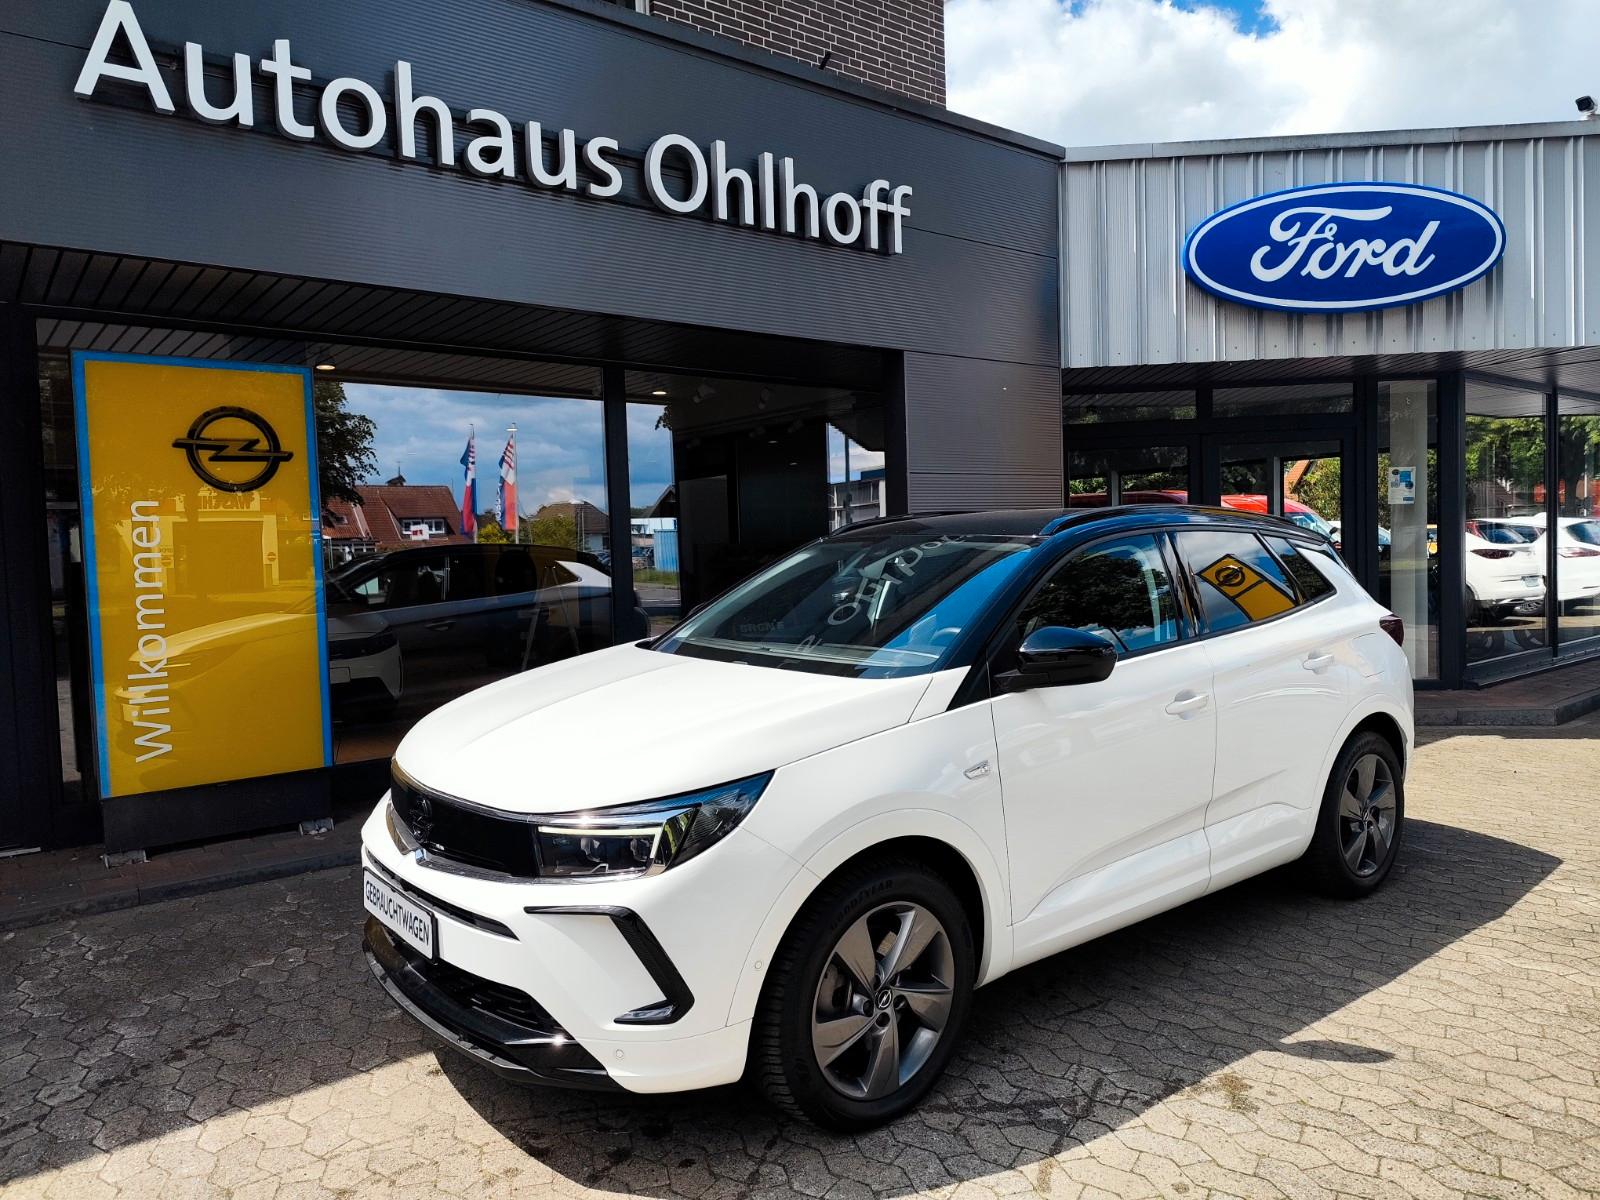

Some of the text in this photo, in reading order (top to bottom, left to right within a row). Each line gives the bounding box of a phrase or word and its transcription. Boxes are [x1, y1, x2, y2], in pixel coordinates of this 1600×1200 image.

[74, 0, 913, 254] Autohaus Ohlhoff
[1250, 205, 1441, 282] Ford
[127, 500, 173, 763] Willkommen
[366, 881, 429, 946] GEBRAUCHTWAGEN
